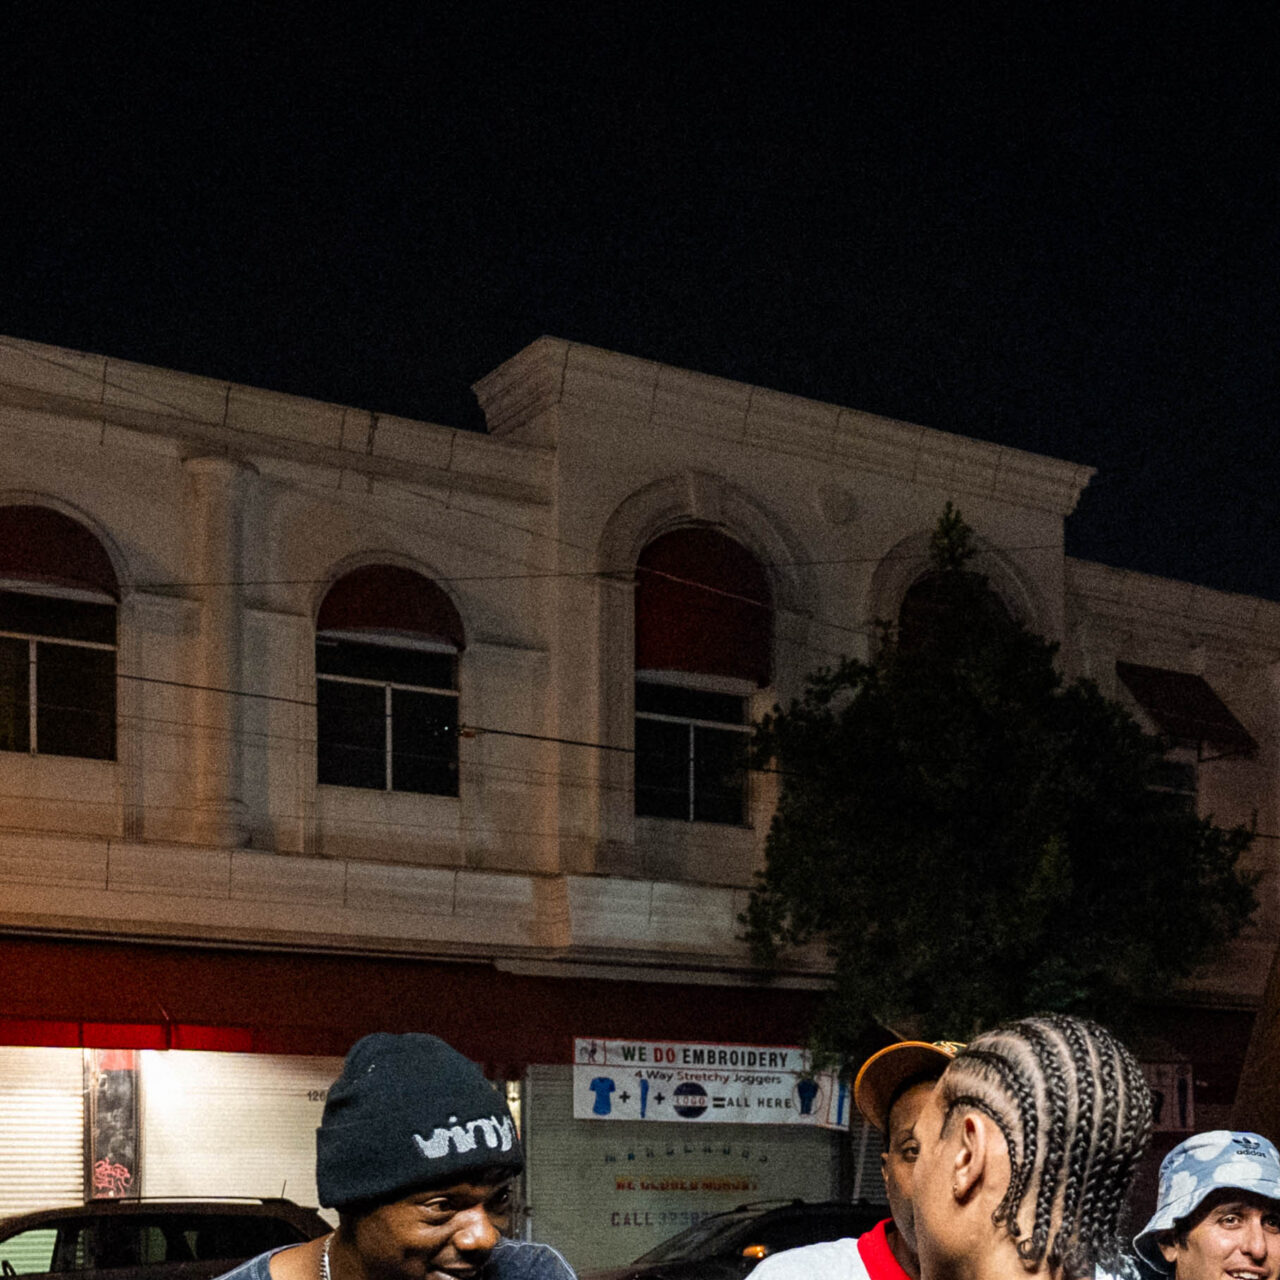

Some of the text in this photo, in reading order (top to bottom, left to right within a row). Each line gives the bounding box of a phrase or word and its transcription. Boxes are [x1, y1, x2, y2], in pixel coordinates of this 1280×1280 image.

[621, 1046, 789, 1068] WE DO EMBROIDERY
[645, 1070, 674, 1082] Way
[676, 1072, 730, 1085] Stretchy
[733, 1073, 782, 1085] Joggers
[726, 1097, 792, 1109] ALL HERE
[611, 1212, 654, 1227] CALL
